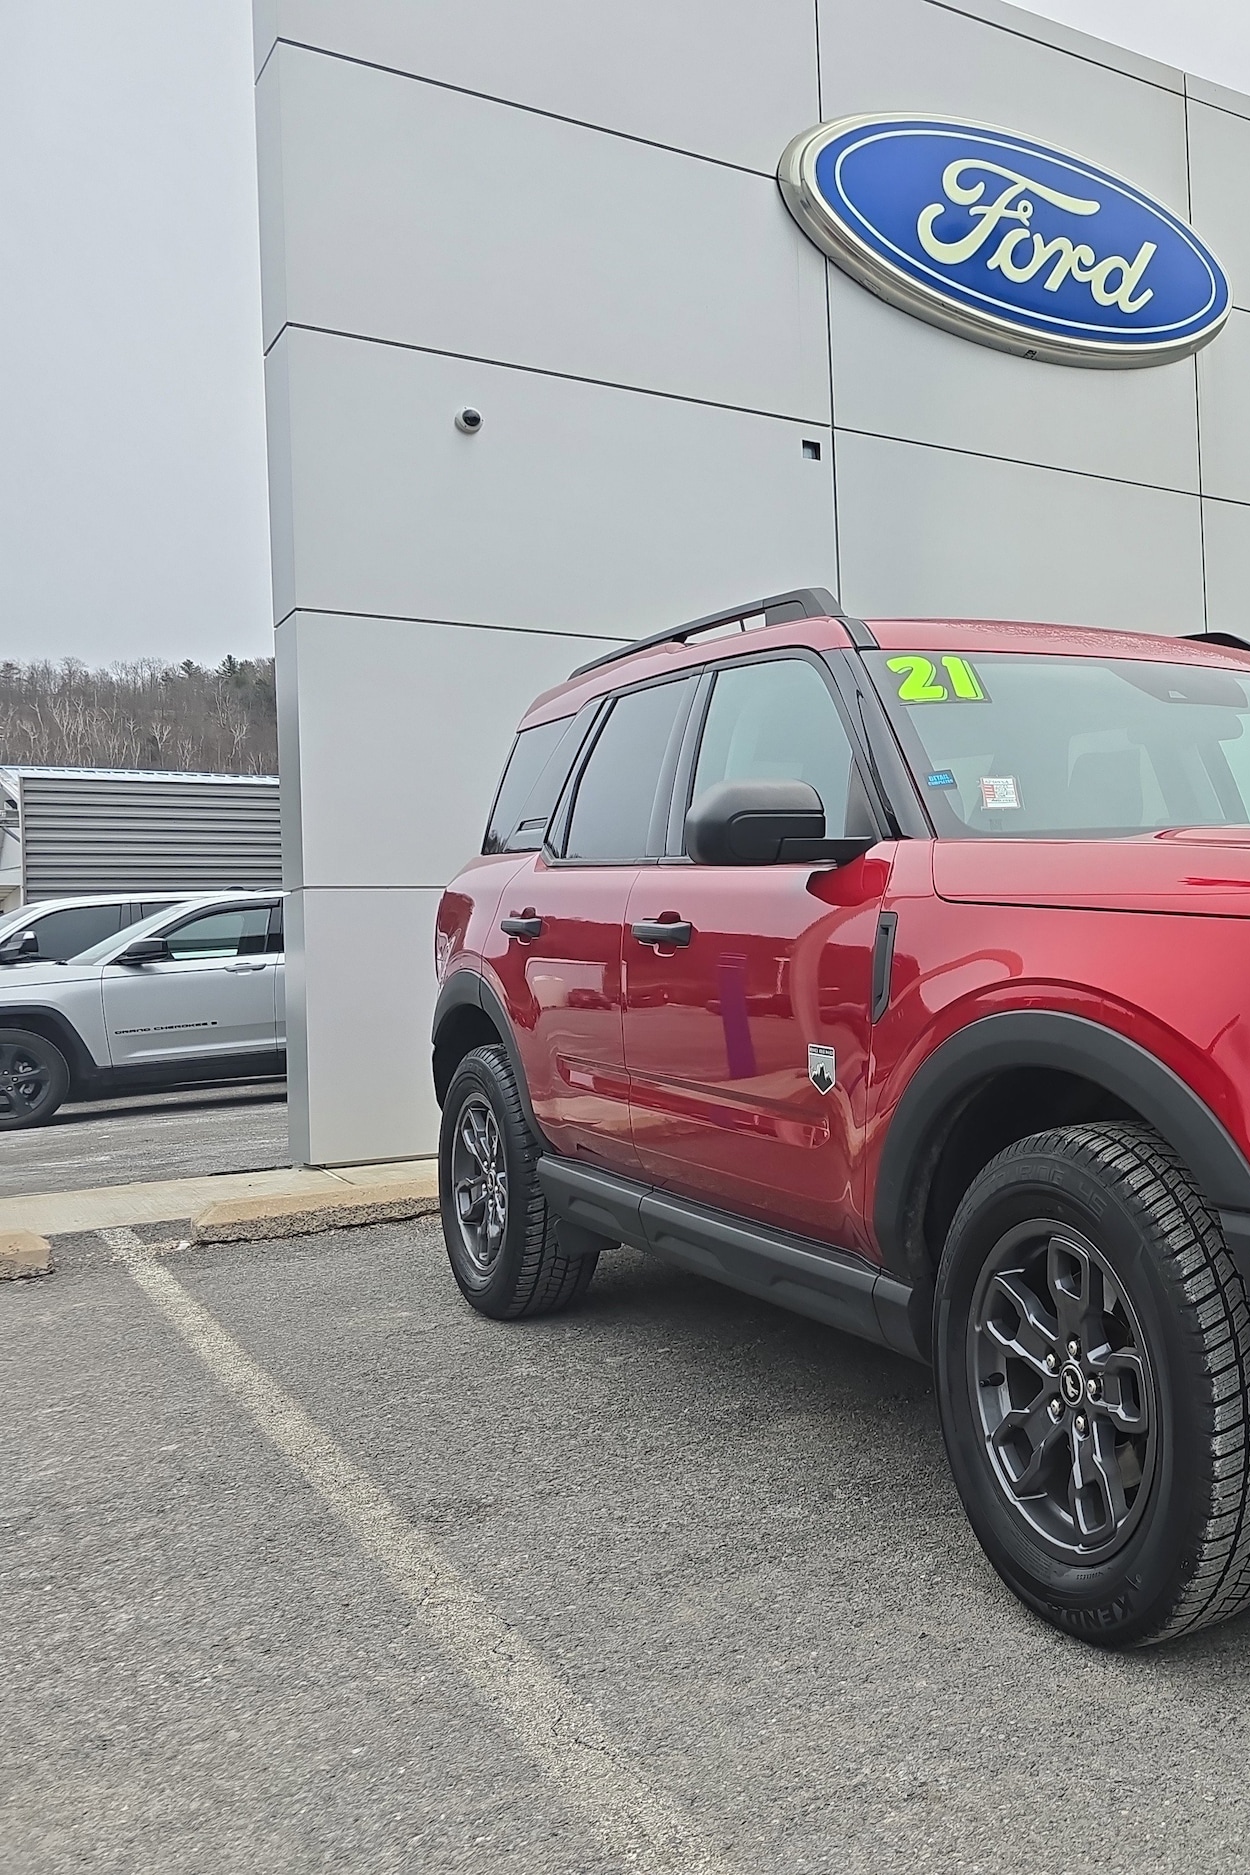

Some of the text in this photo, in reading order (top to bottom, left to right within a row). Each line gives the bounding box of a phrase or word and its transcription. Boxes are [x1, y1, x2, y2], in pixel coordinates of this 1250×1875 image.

[917, 157, 1158, 314] Ford
[886, 655, 984, 702] 21
[114, 1027, 151, 1035] GRAND
[153, 1021, 208, 1031] CHEROKEE
